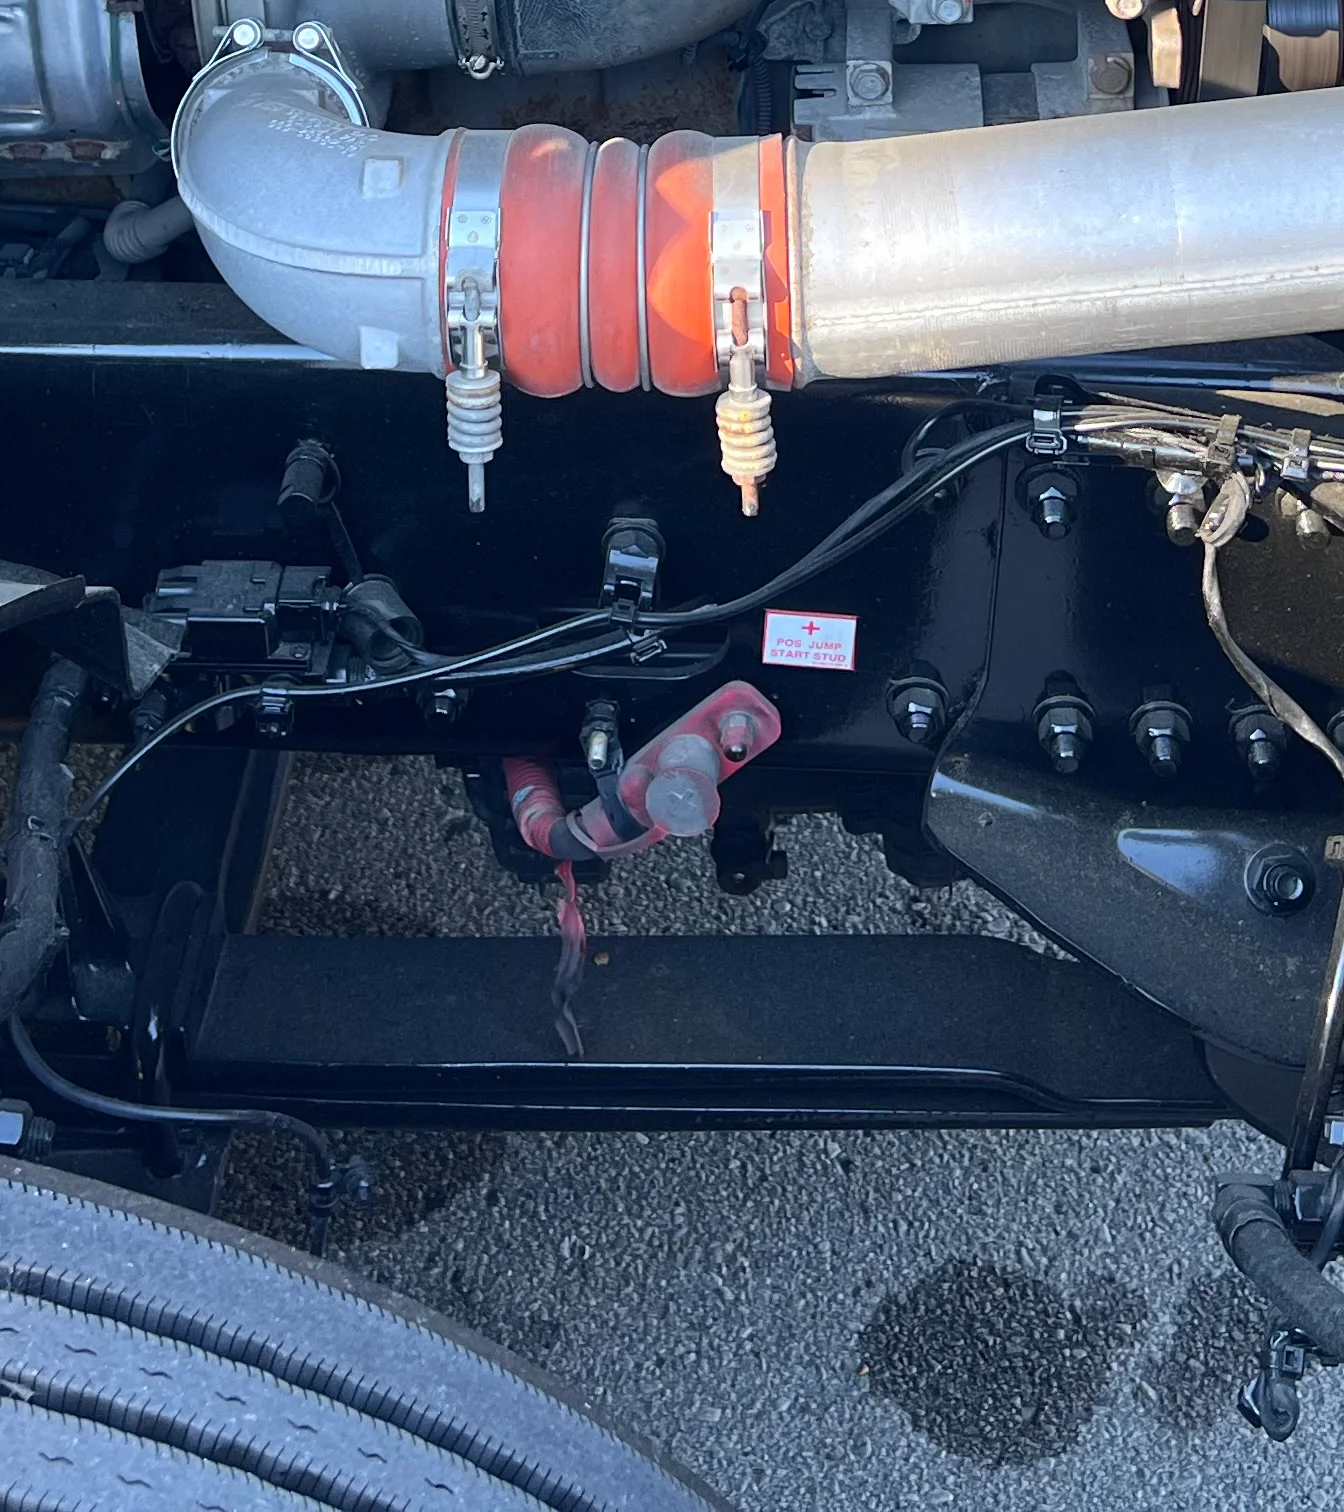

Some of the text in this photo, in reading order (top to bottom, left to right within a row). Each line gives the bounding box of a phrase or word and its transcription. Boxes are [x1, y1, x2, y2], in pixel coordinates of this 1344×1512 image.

[776, 637, 843, 651] POS JUMP
[770, 649, 847, 663] START STUD
